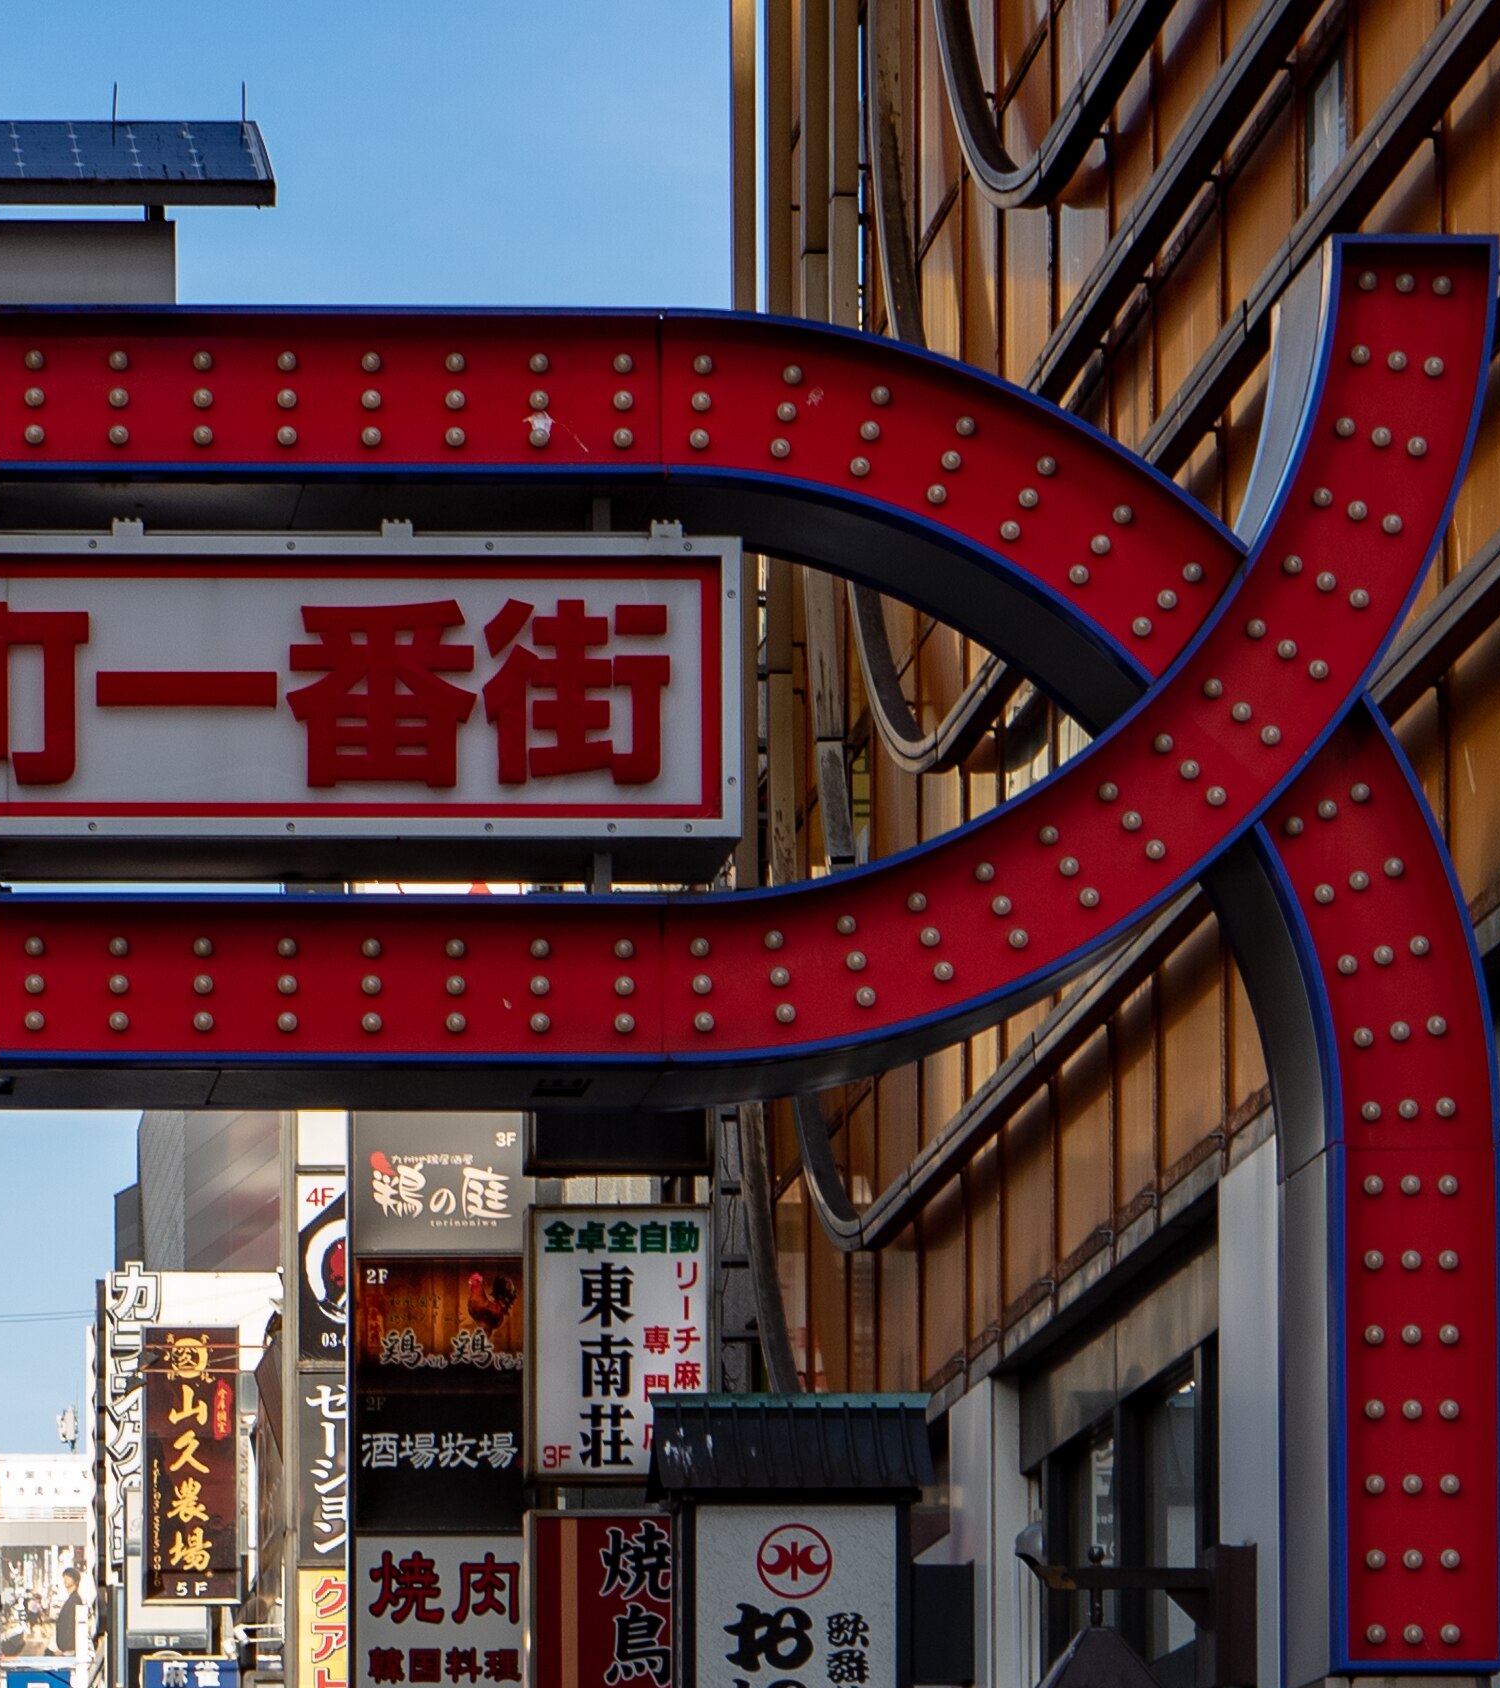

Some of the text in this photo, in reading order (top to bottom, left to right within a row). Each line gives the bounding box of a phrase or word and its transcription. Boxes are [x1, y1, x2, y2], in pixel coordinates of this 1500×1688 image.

[495, 1132, 517, 1148] 3F
[303, 1186, 335, 1207] 4F
[371, 1162, 513, 1220] 鶏の庭
[544, 1220, 700, 1254] 全卓全自動
[366, 1269, 389, 1284] 2F
[579, 1262, 635, 1469] 東南荘
[361, 1432, 519, 1470] 酒場牧場
[543, 1445, 572, 1469] 3F
[176, 1581, 209, 1597] 5F
[368, 1550, 521, 1625] 焼肉
[162, 1660, 221, 1688] 麻雀
[367, 1646, 522, 1685] 韓国料理
